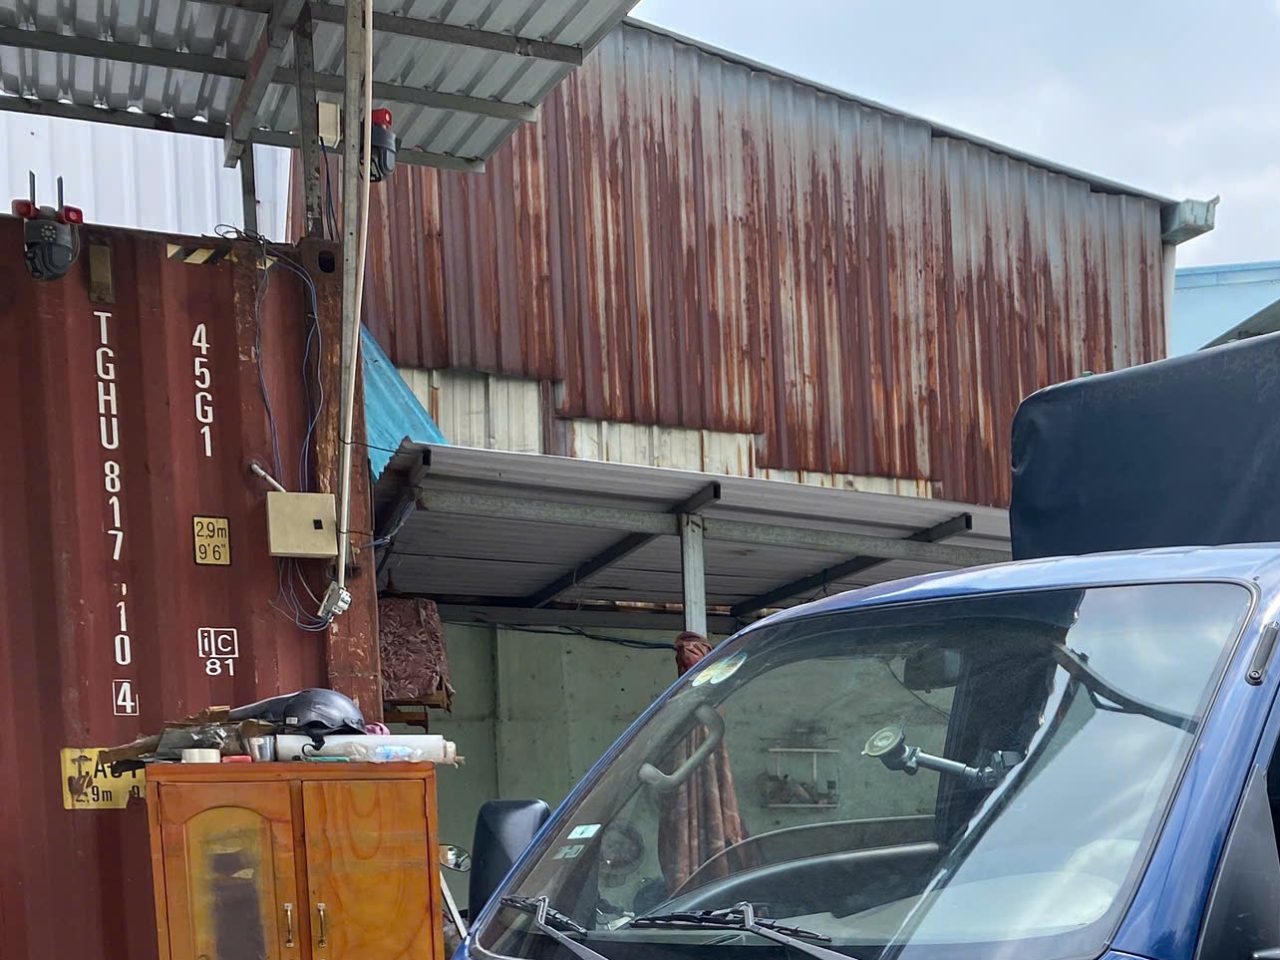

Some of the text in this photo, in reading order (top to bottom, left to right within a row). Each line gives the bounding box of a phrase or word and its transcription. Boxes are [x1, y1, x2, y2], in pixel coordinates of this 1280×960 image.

[93, 311, 119, 450] TGHU
[192, 323, 214, 457] 45G1
[205, 658, 235, 676] 81
